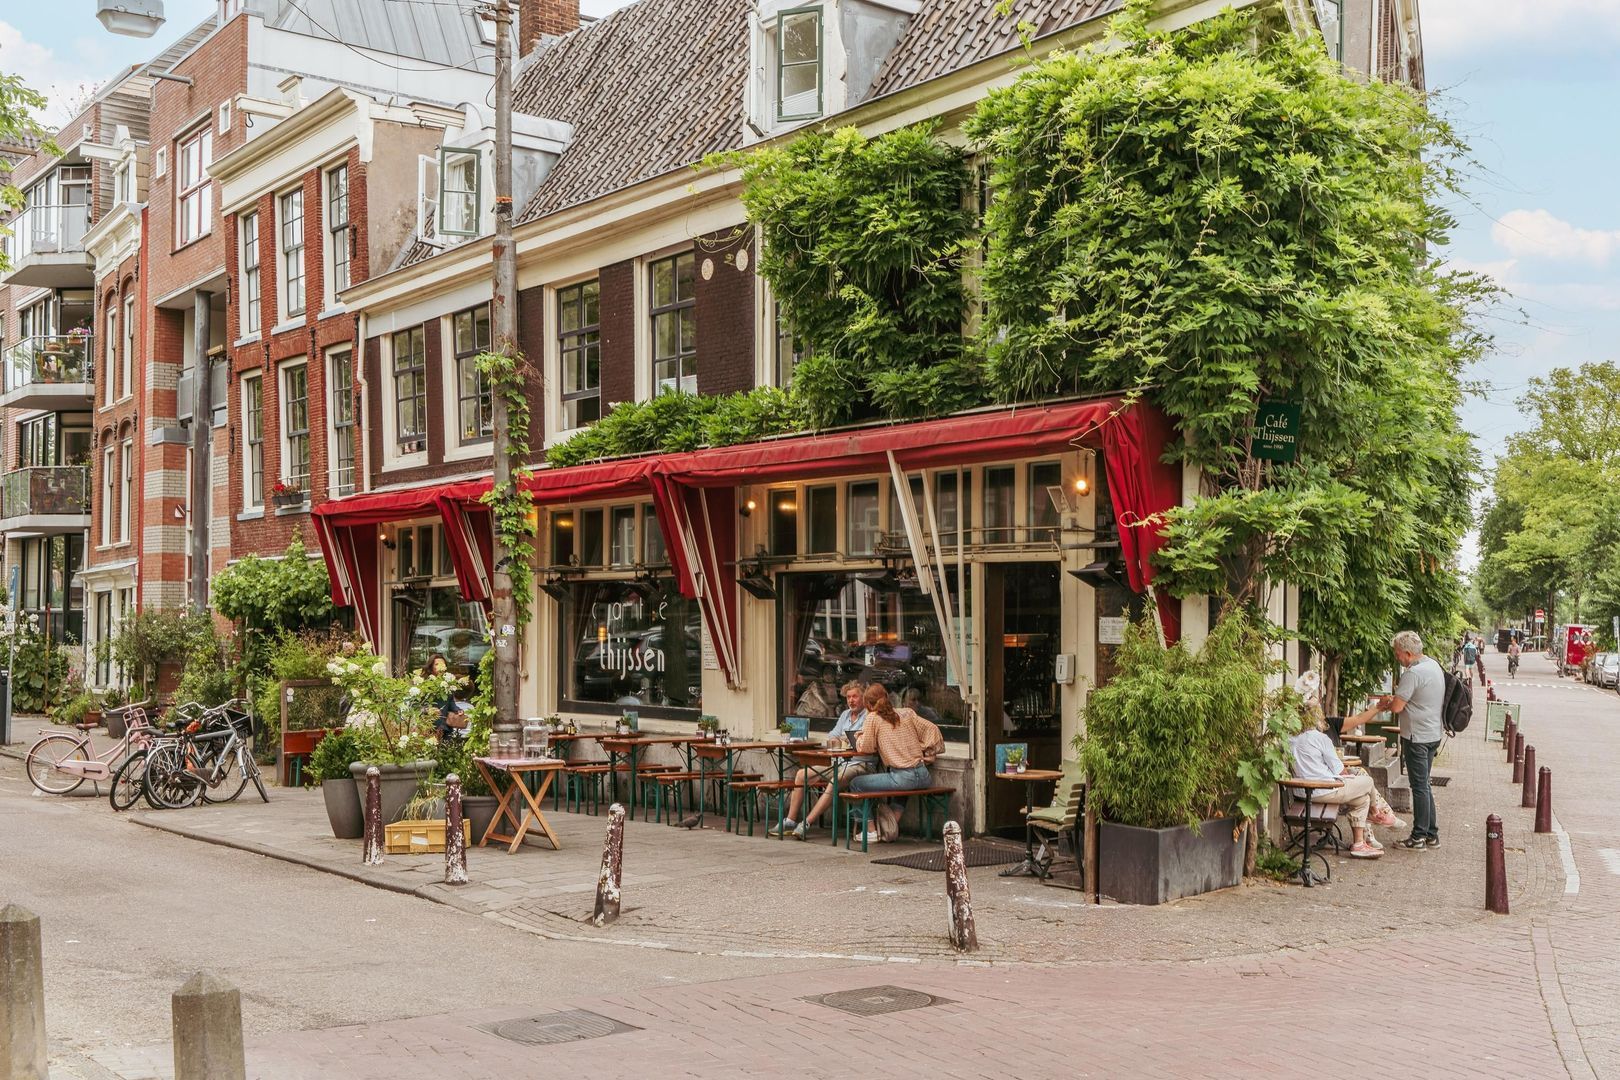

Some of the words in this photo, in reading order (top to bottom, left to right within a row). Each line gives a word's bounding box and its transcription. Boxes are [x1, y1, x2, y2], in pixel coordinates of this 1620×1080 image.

[1265, 413, 1288, 428] Café
[1255, 426, 1295, 444] Thijssen
[600, 632, 665, 680] thijssen
